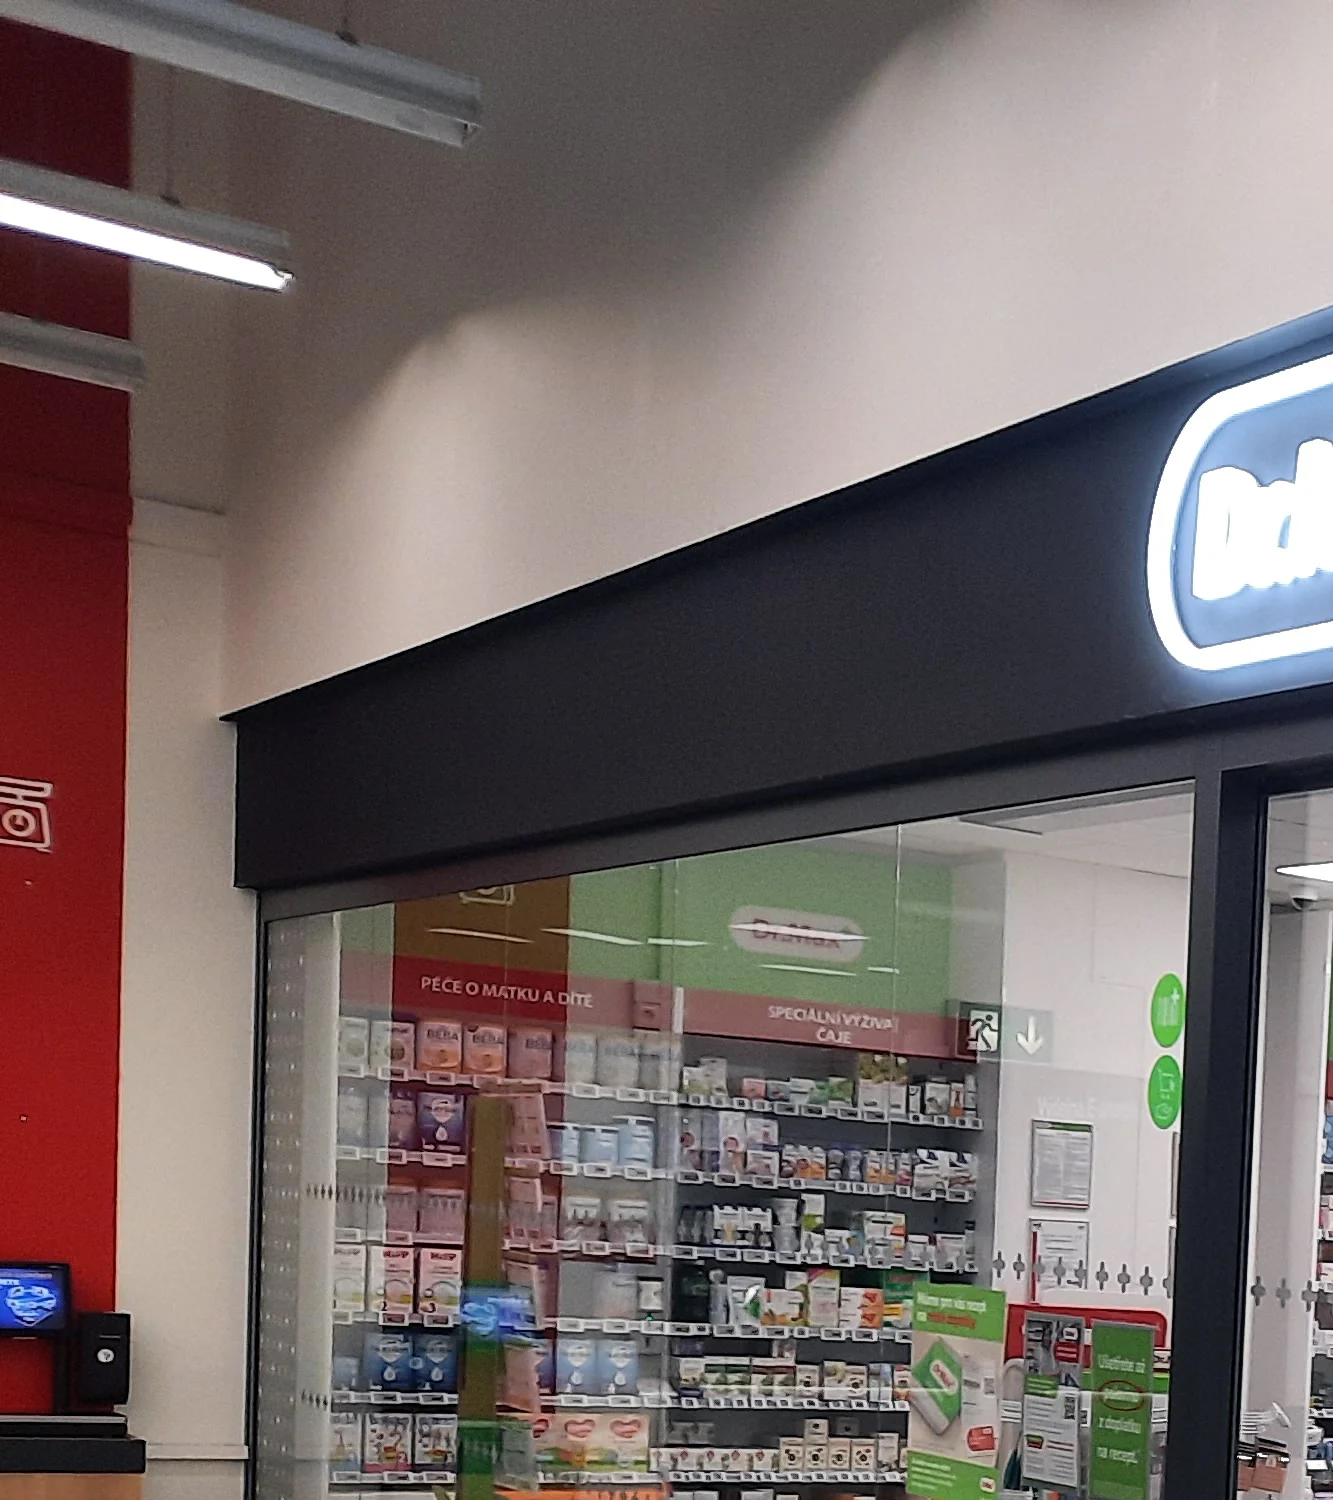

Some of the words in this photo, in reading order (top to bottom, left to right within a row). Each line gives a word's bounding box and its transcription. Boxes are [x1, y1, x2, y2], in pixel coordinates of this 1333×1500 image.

[421, 976, 462, 994] PÉČE
[466, 981, 479, 996] O
[482, 982, 540, 1002] MATKU
[543, 989, 556, 1005] A
[768, 1005, 842, 1024] SPECIÁLNÍ
[816, 1027, 852, 1044] ČAJE
